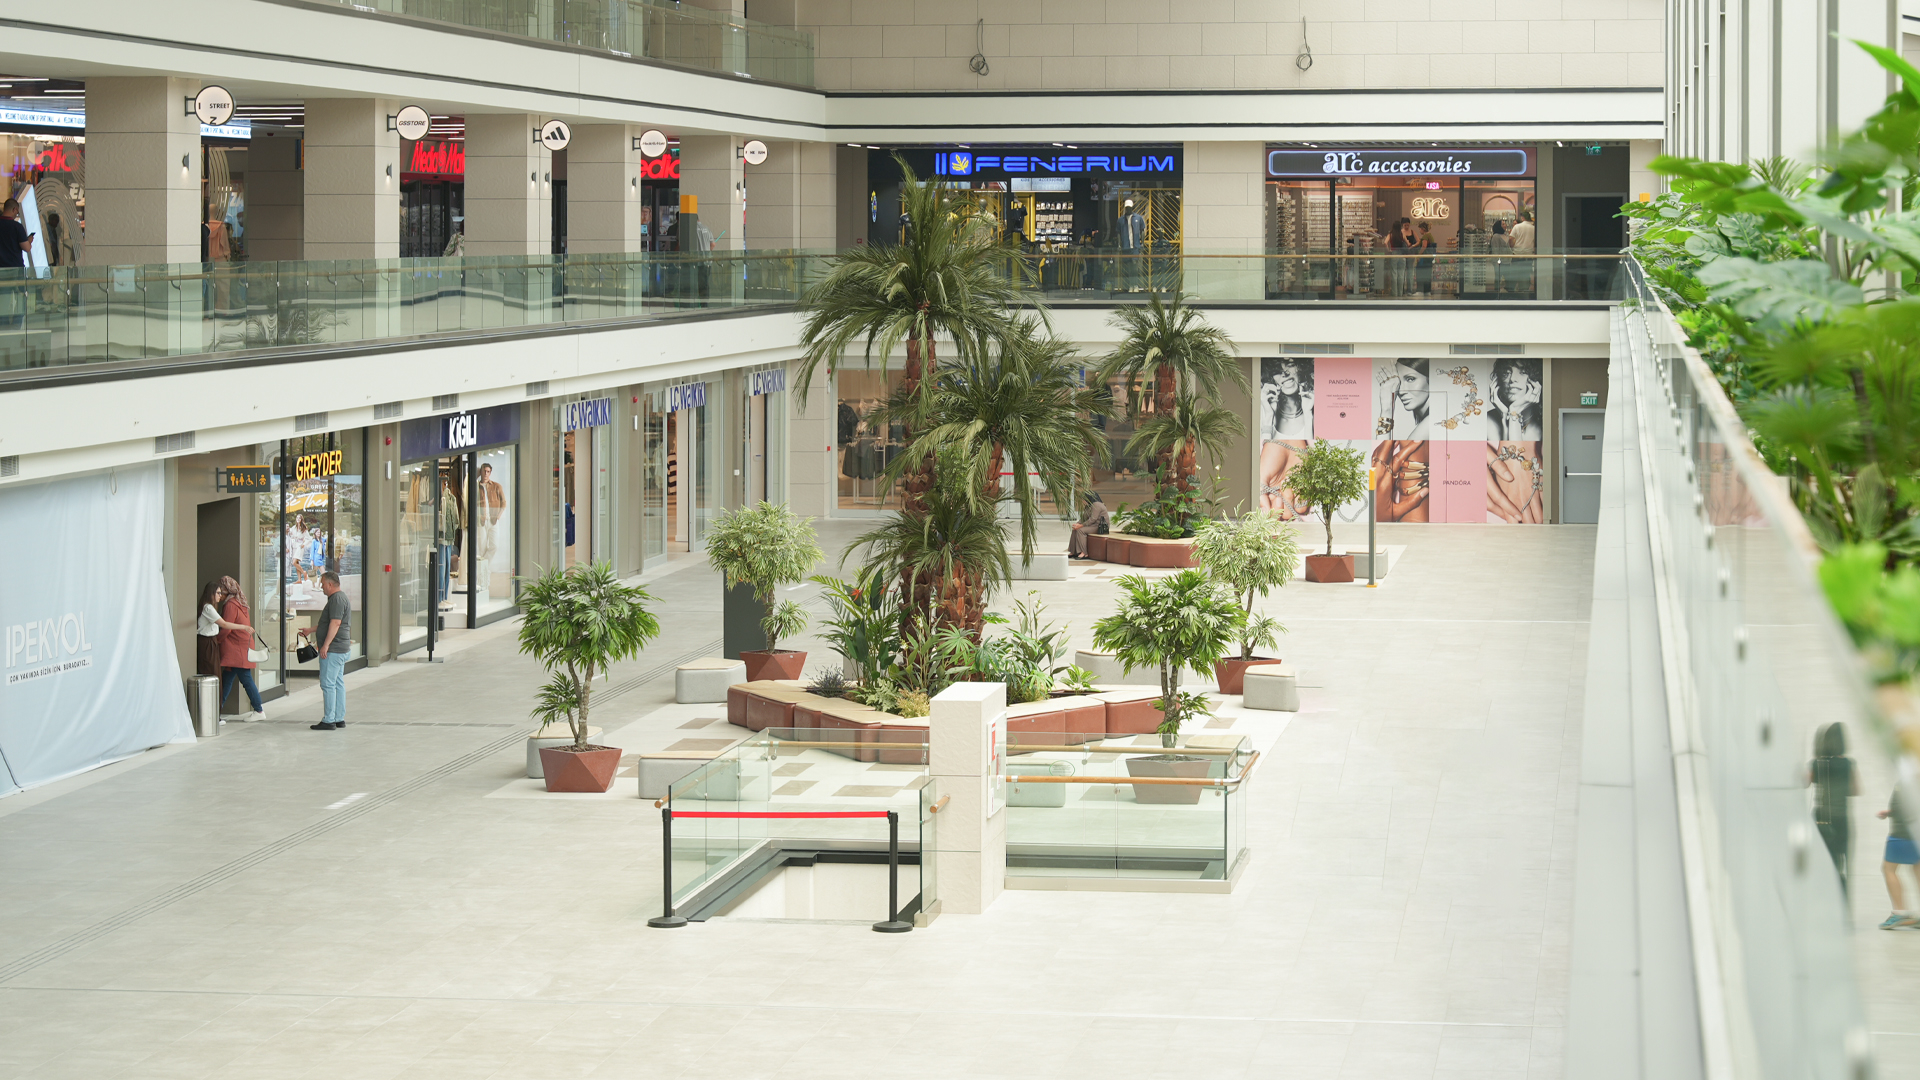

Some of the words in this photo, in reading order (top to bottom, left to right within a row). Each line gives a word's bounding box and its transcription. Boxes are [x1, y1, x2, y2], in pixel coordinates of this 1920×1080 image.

[975, 156, 1175, 172] FENERIUM
[1322, 152, 1364, 174] arc
[1368, 156, 1472, 173] accessories
[1411, 197, 1450, 219] arc
[670, 386, 680, 413] LC
[1581, 396, 1597, 405] EXIT
[566, 403, 578, 432] LC
[296, 449, 343, 482] GREYDER
[5, 610, 92, 669] IPEKYOL
